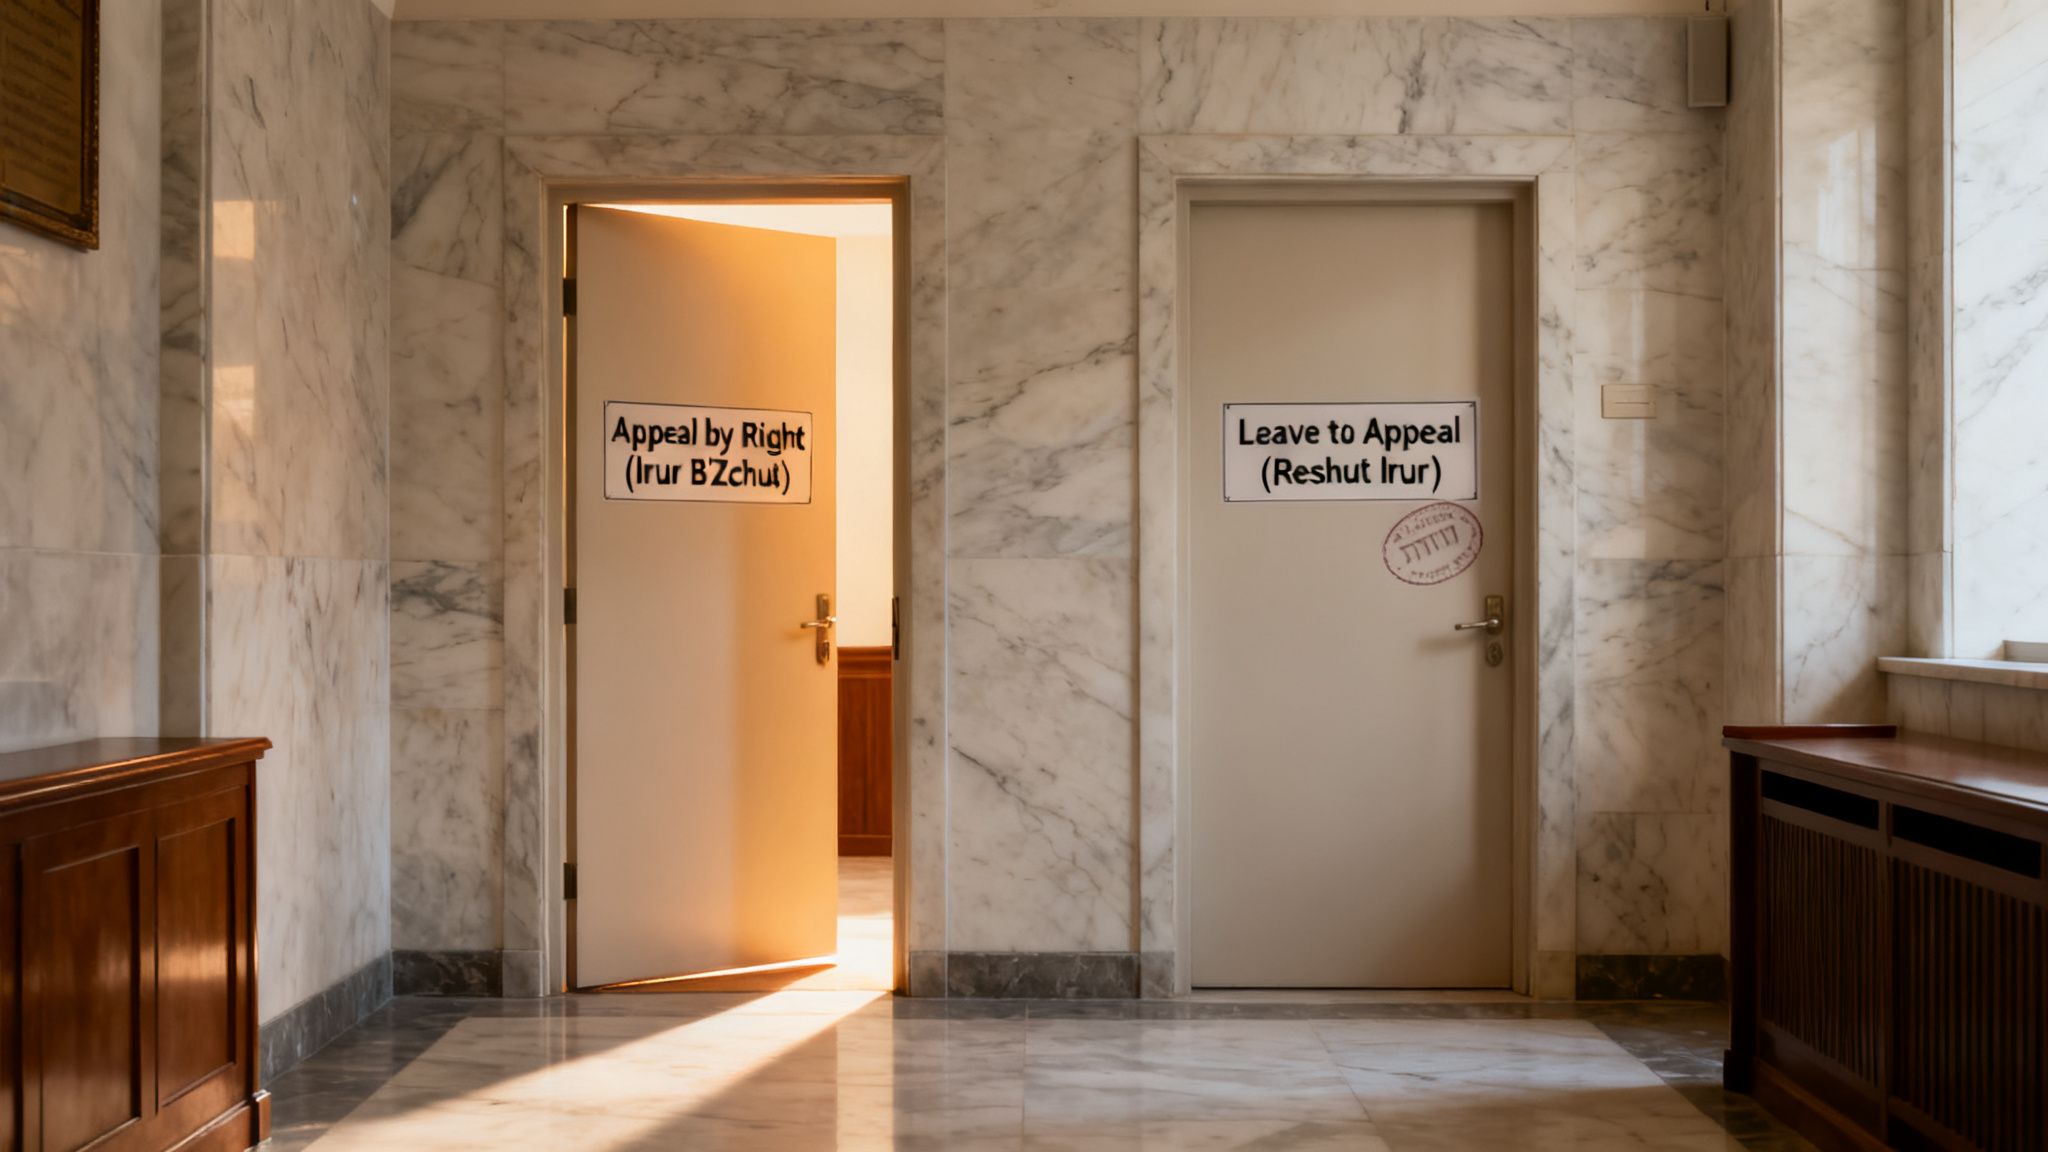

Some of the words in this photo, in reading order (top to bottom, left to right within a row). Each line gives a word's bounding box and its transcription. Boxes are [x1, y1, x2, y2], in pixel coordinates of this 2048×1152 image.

[611, 415, 698, 452] Appeal
[704, 417, 734, 456] by
[742, 420, 805, 457] Right
[1239, 418, 1320, 446] Leave
[1327, 420, 1355, 445] to
[1362, 415, 1461, 452] Appeal
[625, 454, 682, 494] (Irur
[1261, 455, 1372, 494] (Reshut
[1381, 455, 1442, 494] Irur)
